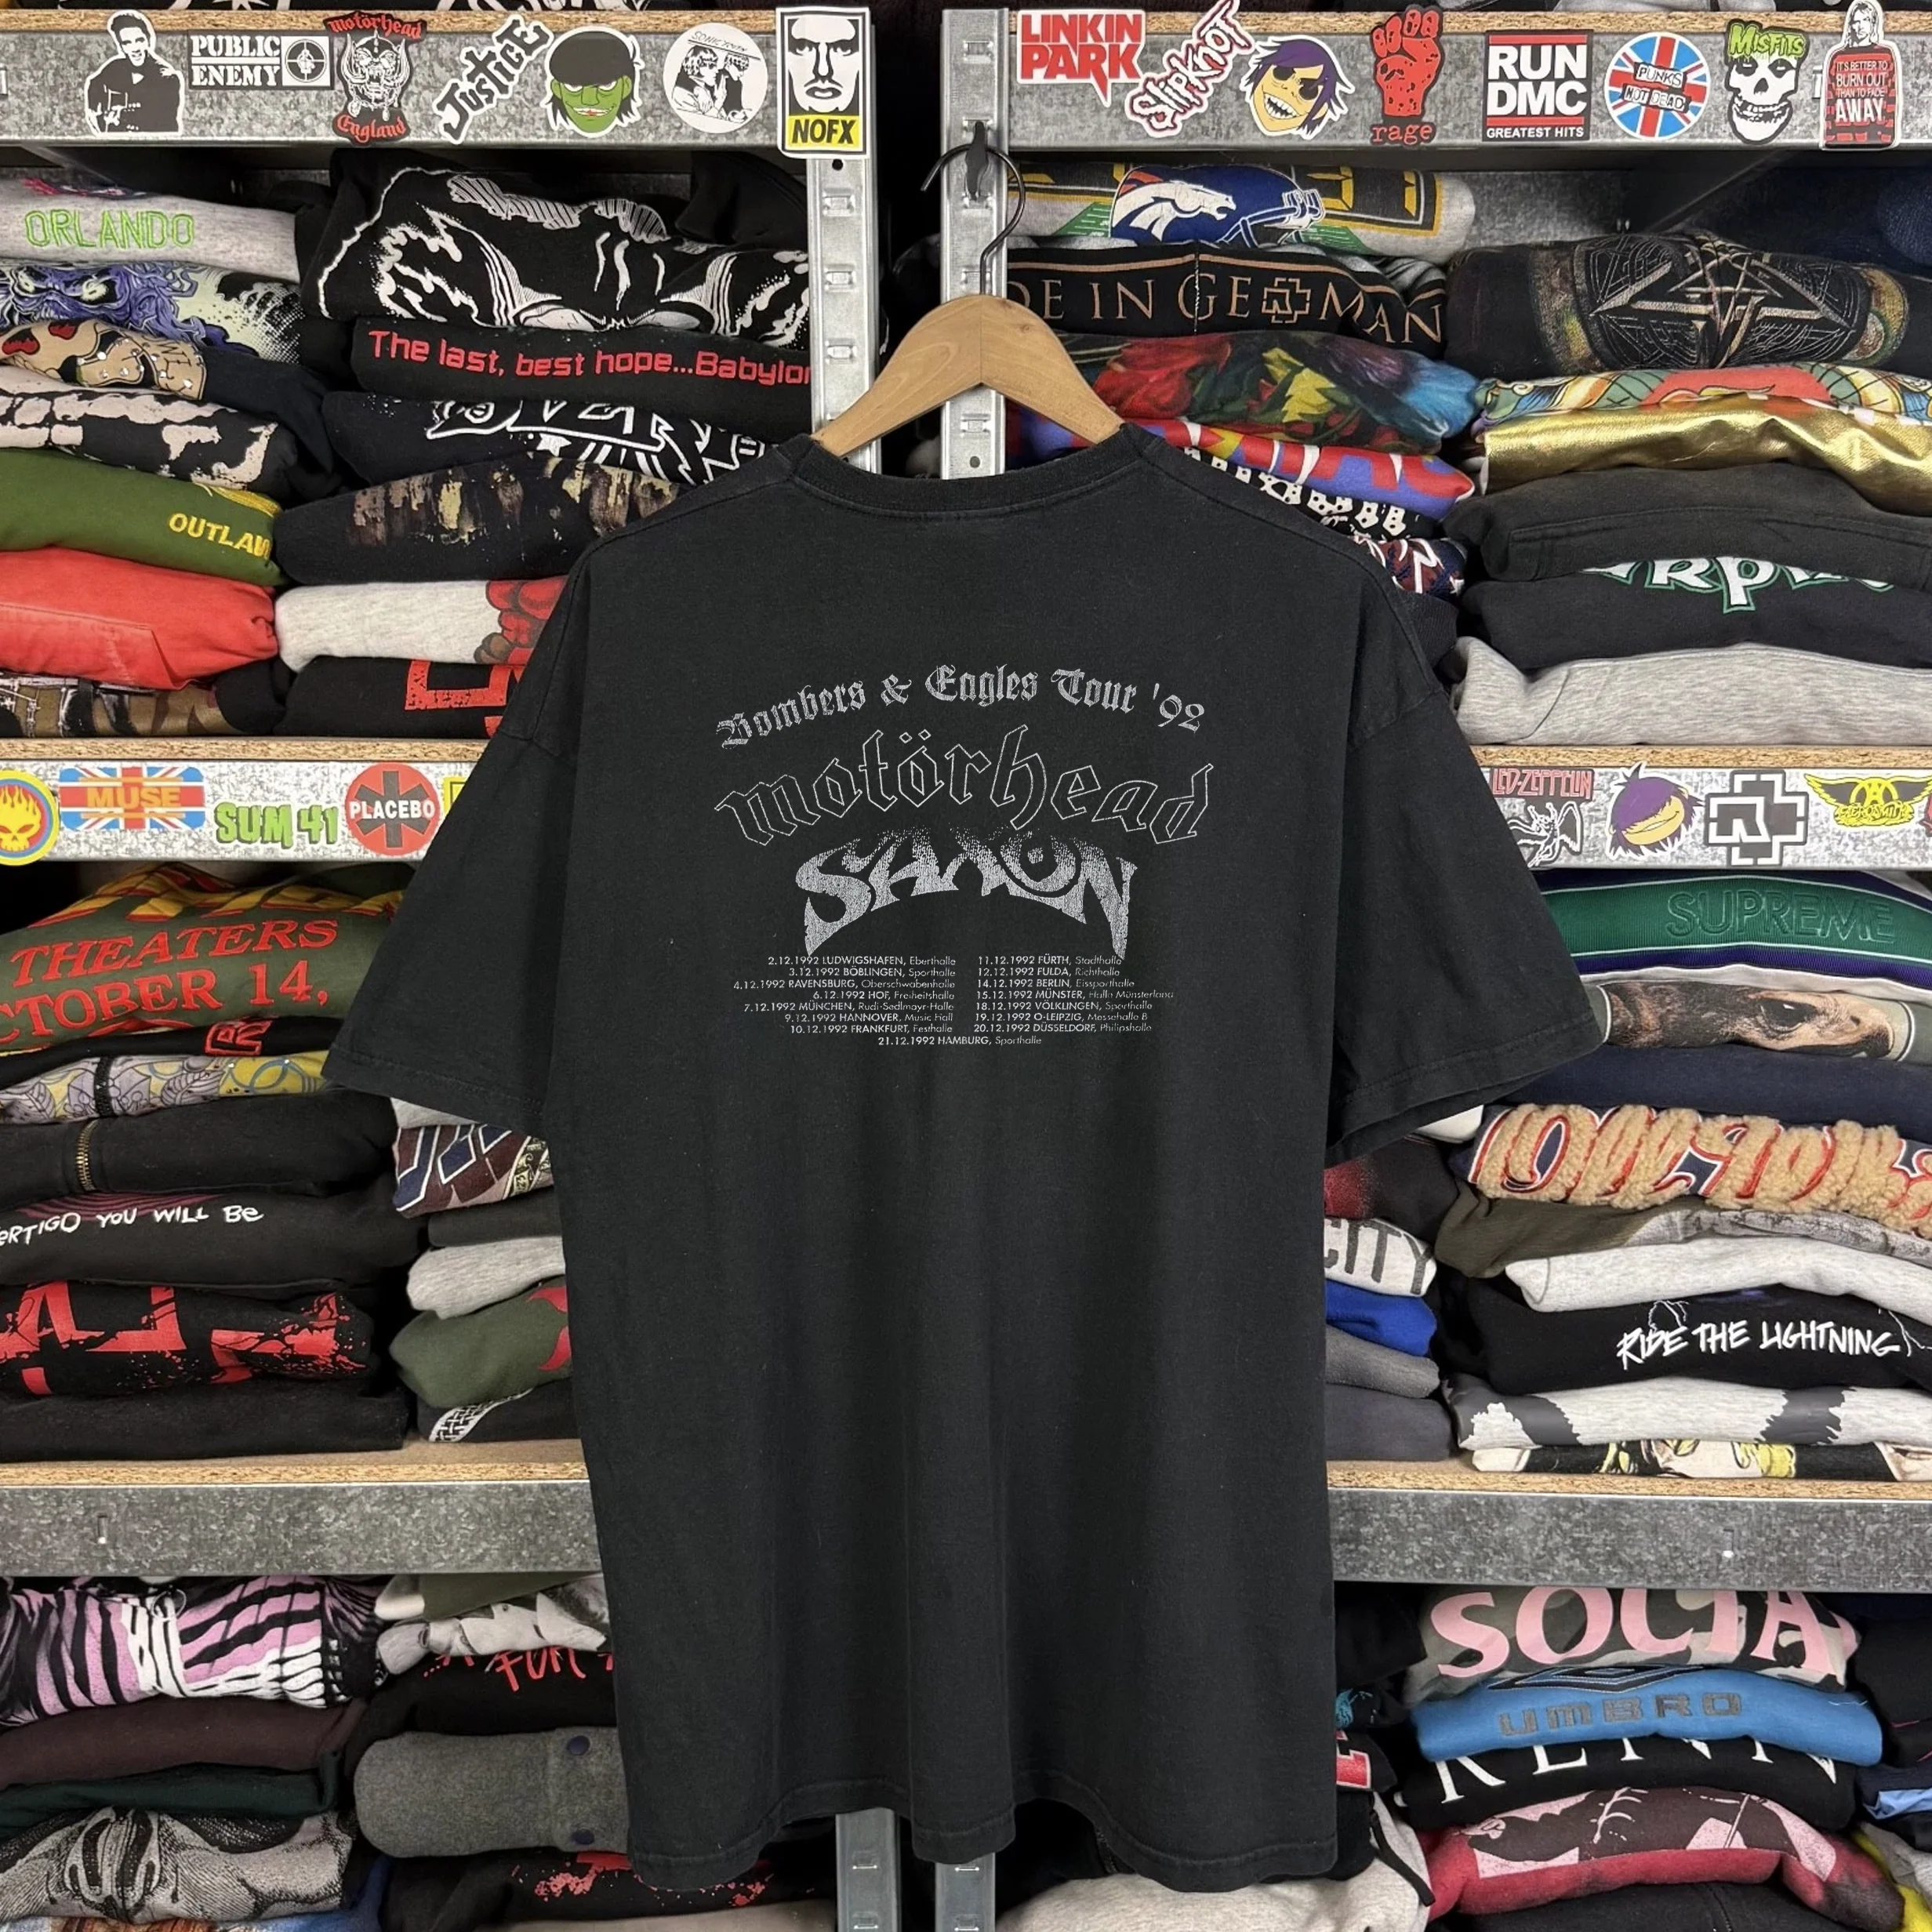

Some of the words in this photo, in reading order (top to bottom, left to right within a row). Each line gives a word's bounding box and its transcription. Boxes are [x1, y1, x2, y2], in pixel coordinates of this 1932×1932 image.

[1022, 14, 1142, 45] LINKIN
[191, 35, 281, 56] PUBLIC
[1021, 44, 1142, 100] PARK
[1487, 45, 1588, 79] RUN
[1850, 61, 1876, 71] BETTER
[1878, 60, 1887, 71] TO
[191, 65, 281, 86] ENEMY
[1638, 66, 1683, 86] PUNKS
[1836, 73, 1865, 87] BURN
[1867, 72, 1887, 86] OUT
[1487, 81, 1587, 116] DMC
[1625, 86, 1647, 101] NOT
[1651, 91, 1685, 109] DEAD
[1836, 98, 1883, 123] AWAY
[792, 119, 856, 144] NOFX
[1372, 125, 1433, 144] rage
[1487, 127, 1551, 139] GREATEST
[1555, 126, 1584, 137] HITS
[24, 209, 194, 249] ORLANDO
[1089, 279, 1155, 319] IN
[368, 331, 430, 361] The
[439, 339, 504, 376] last,
[515, 353, 585, 376] best
[716, 681, 866, 749] Bombers
[881, 674, 912, 706] &
[925, 663, 1038, 707] Eagles
[1051, 668, 1137, 714] Tour
[1152, 682, 1204, 733] '92
[87, 786, 181, 809] MUSE
[349, 800, 436, 819] PLACEBO
[214, 801, 294, 849] SUM
[297, 804, 339, 845] 41
[794, 824, 1138, 959] SAXON
[1665, 888, 1897, 944] SUPREME
[10, 919, 339, 988] THEATERS
[768, 956, 819, 965] 2.12.1992
[823, 956, 906, 966] LUDWIGSHAFEN,
[978, 956, 1035, 965] 11.12.1992
[1037, 953, 1071, 965] FÜRTH,
[789, 968, 840, 977] 3.12.1992
[843, 965, 906, 978] BÖBLINGEN,
[978, 967, 1034, 976] 12.12.1992
[1037, 967, 1072, 977] FULDA,
[250, 961, 329, 1007] 14,
[733, 980, 785, 990] 4.12.1992
[788, 979, 858, 990] RAVENSBURG,
[976, 990, 1033, 1000] 15.12.1992
[1035, 988, 1085, 1000] MÜNSTER,
[978, 979, 1033, 988] 14.12.1992
[1036, 979, 1073, 989] BERLIN,
[744, 1003, 795, 1012] 7.12.1992
[799, 1000, 855, 1012] MÜNCHEN,
[812, 991, 865, 1000] 6.12.1992
[868, 991, 891, 1000] HOF,
[976, 1001, 1031, 1011] 18.12.1992
[1034, 1000, 1102, 1011] VÖLKLINGEN,
[785, 1013, 836, 1022] 9.12.1992
[839, 1013, 902, 1022] HANNOVER,
[974, 1024, 1030, 1033] 20.12.1992
[1033, 1021, 1097, 1033] DÜSSELDORF,
[975, 1012, 1031, 1022] 19.12.1992
[1033, 1012, 1084, 1022] O-LEIPZIG,
[790, 1025, 848, 1034] 10.12.1992
[851, 1025, 910, 1034] FRANKFURT,
[878, 1036, 935, 1045] 21.12.1992
[938, 1036, 992, 1045] HAMBURG,
[1615, 1325, 1688, 1371] RIDE
[1692, 1320, 1751, 1354] THE
[1760, 1320, 1901, 1357] LIGHTNING
[1429, 1585, 1860, 1687] SOCIA
[1498, 1692, 1742, 1737] UMBRO
